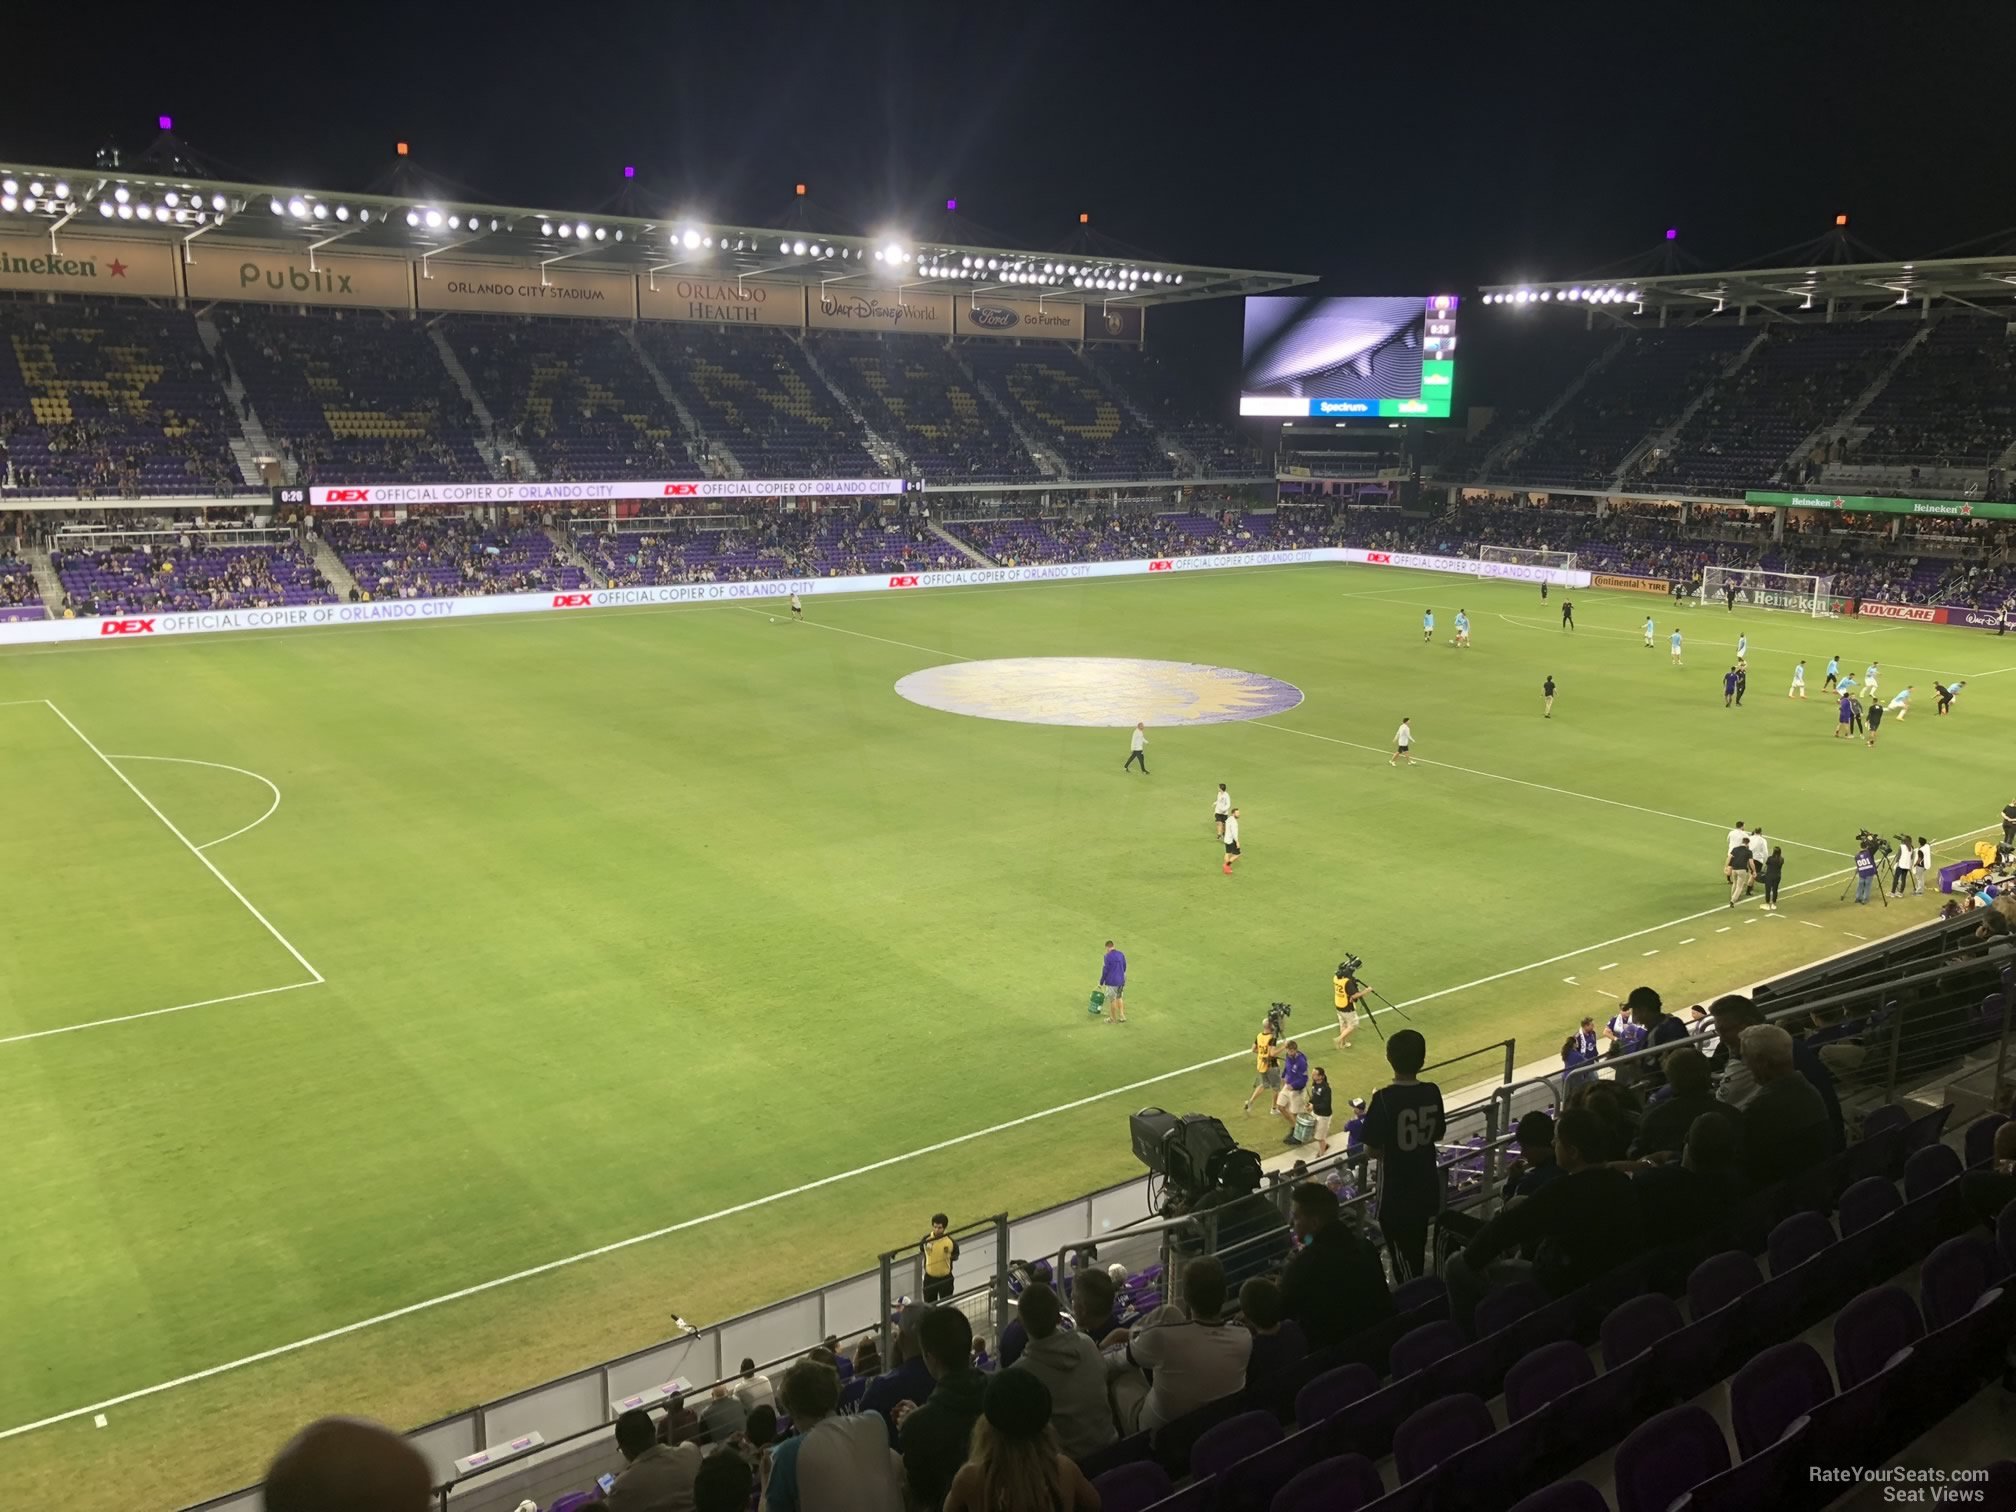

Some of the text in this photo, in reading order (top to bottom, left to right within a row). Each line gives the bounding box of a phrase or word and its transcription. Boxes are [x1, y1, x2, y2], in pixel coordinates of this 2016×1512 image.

[0, 252, 97, 277] ineken
[240, 263, 353, 294] Publix
[447, 281, 605, 300] ORLANDO CITY STADIUM
[677, 281, 766, 303] ORLANDO
[689, 302, 757, 321] HEALTH
[901, 304, 935, 320] World
[979, 308, 1010, 326] Ford
[1024, 313, 1071, 326] Go Further
[1320, 401, 1365, 413] Spectrum
[326, 485, 613, 502] DEX OFFICIAL COPIER OF ORLANDO CITY
[664, 481, 891, 495] DEX OFFICIAL COPIER OF ORLANDO CITY
[1792, 498, 1831, 507] Heineken
[1914, 503, 1957, 514] Heineken
[1149, 551, 1313, 571] DEX OFFICIAL COPIER OF ORLANDO CITY
[1367, 552, 1557, 580] DEX OFFICIAL COPIER OF ORLANDO CITY
[889, 566, 1091, 588] DEX OFFICIAL COPIER OF ORLANDO CITY
[1594, 576, 1667, 591] Continental TIRE
[553, 582, 815, 607] DEX OFFICIAL COPIER OF ORLANDO CITY
[1754, 591, 1827, 611] Heineken
[101, 602, 454, 635] DEX OFFICIAL COPIER OF ORLANDO CITY
[1859, 604, 1934, 620] ADVOCARE
[1397, 1105, 1438, 1151] 65
